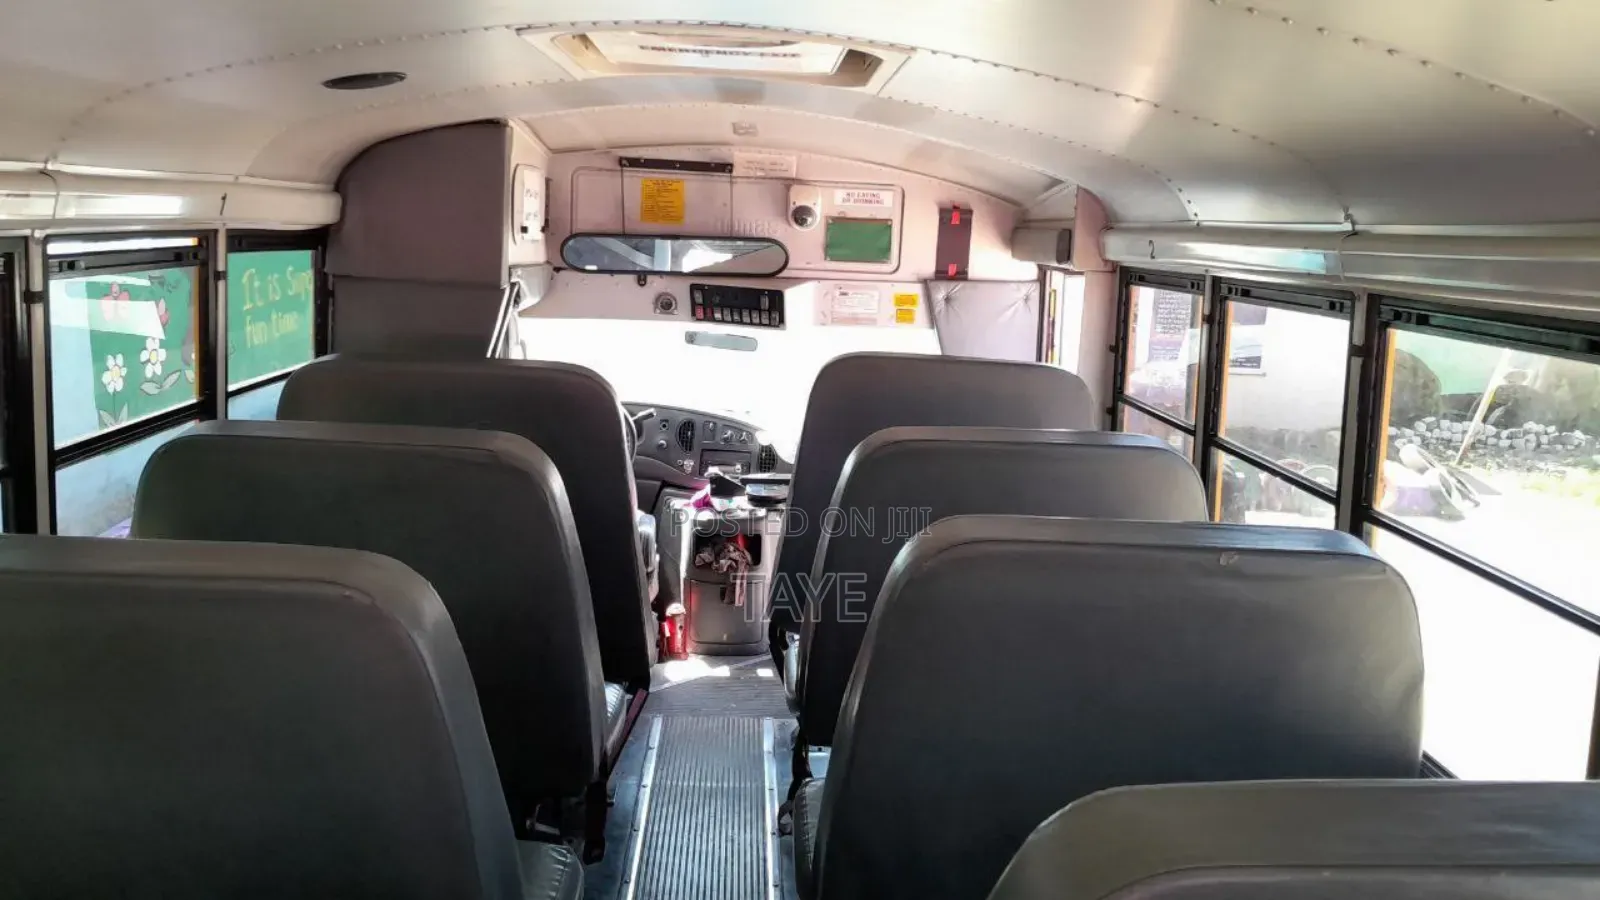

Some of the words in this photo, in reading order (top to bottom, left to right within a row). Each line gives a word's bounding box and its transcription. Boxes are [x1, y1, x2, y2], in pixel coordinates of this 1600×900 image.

[1148, 239, 1156, 260] 2
[242, 267, 265, 311] It
[267, 271, 282, 301] is
